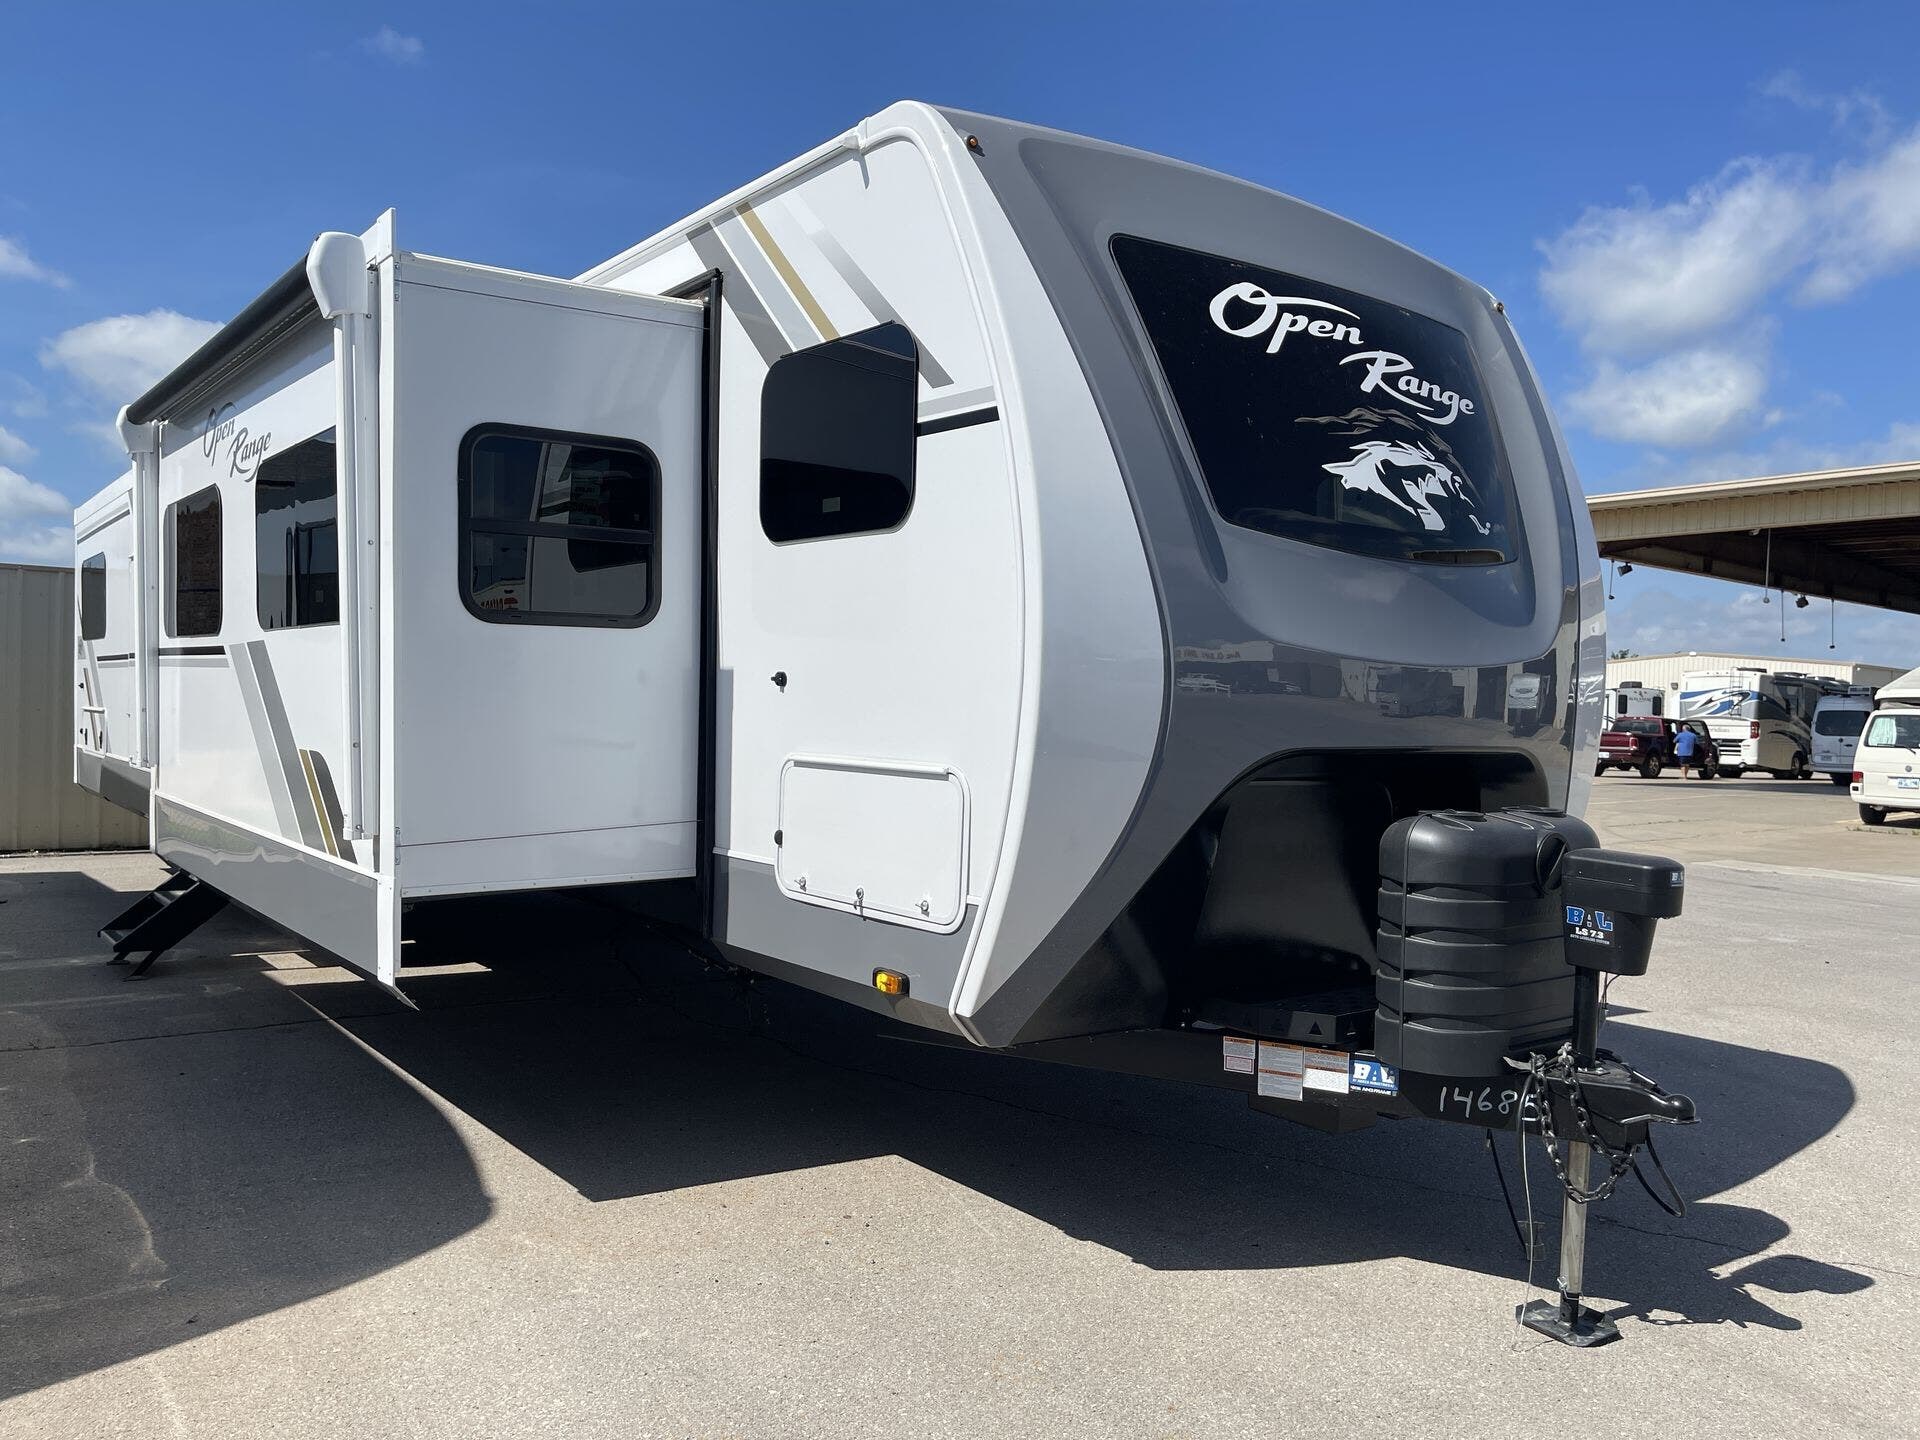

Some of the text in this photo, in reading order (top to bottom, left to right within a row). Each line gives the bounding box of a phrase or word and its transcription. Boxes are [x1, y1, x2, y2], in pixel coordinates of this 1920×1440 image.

[1209, 281, 1364, 354] Open
[1339, 350, 1475, 425] Range
[203, 402, 238, 467] Open
[226, 427, 272, 483] Range
[1575, 927, 1588, 936] LS
[1440, 1086, 1540, 1121] 14685
